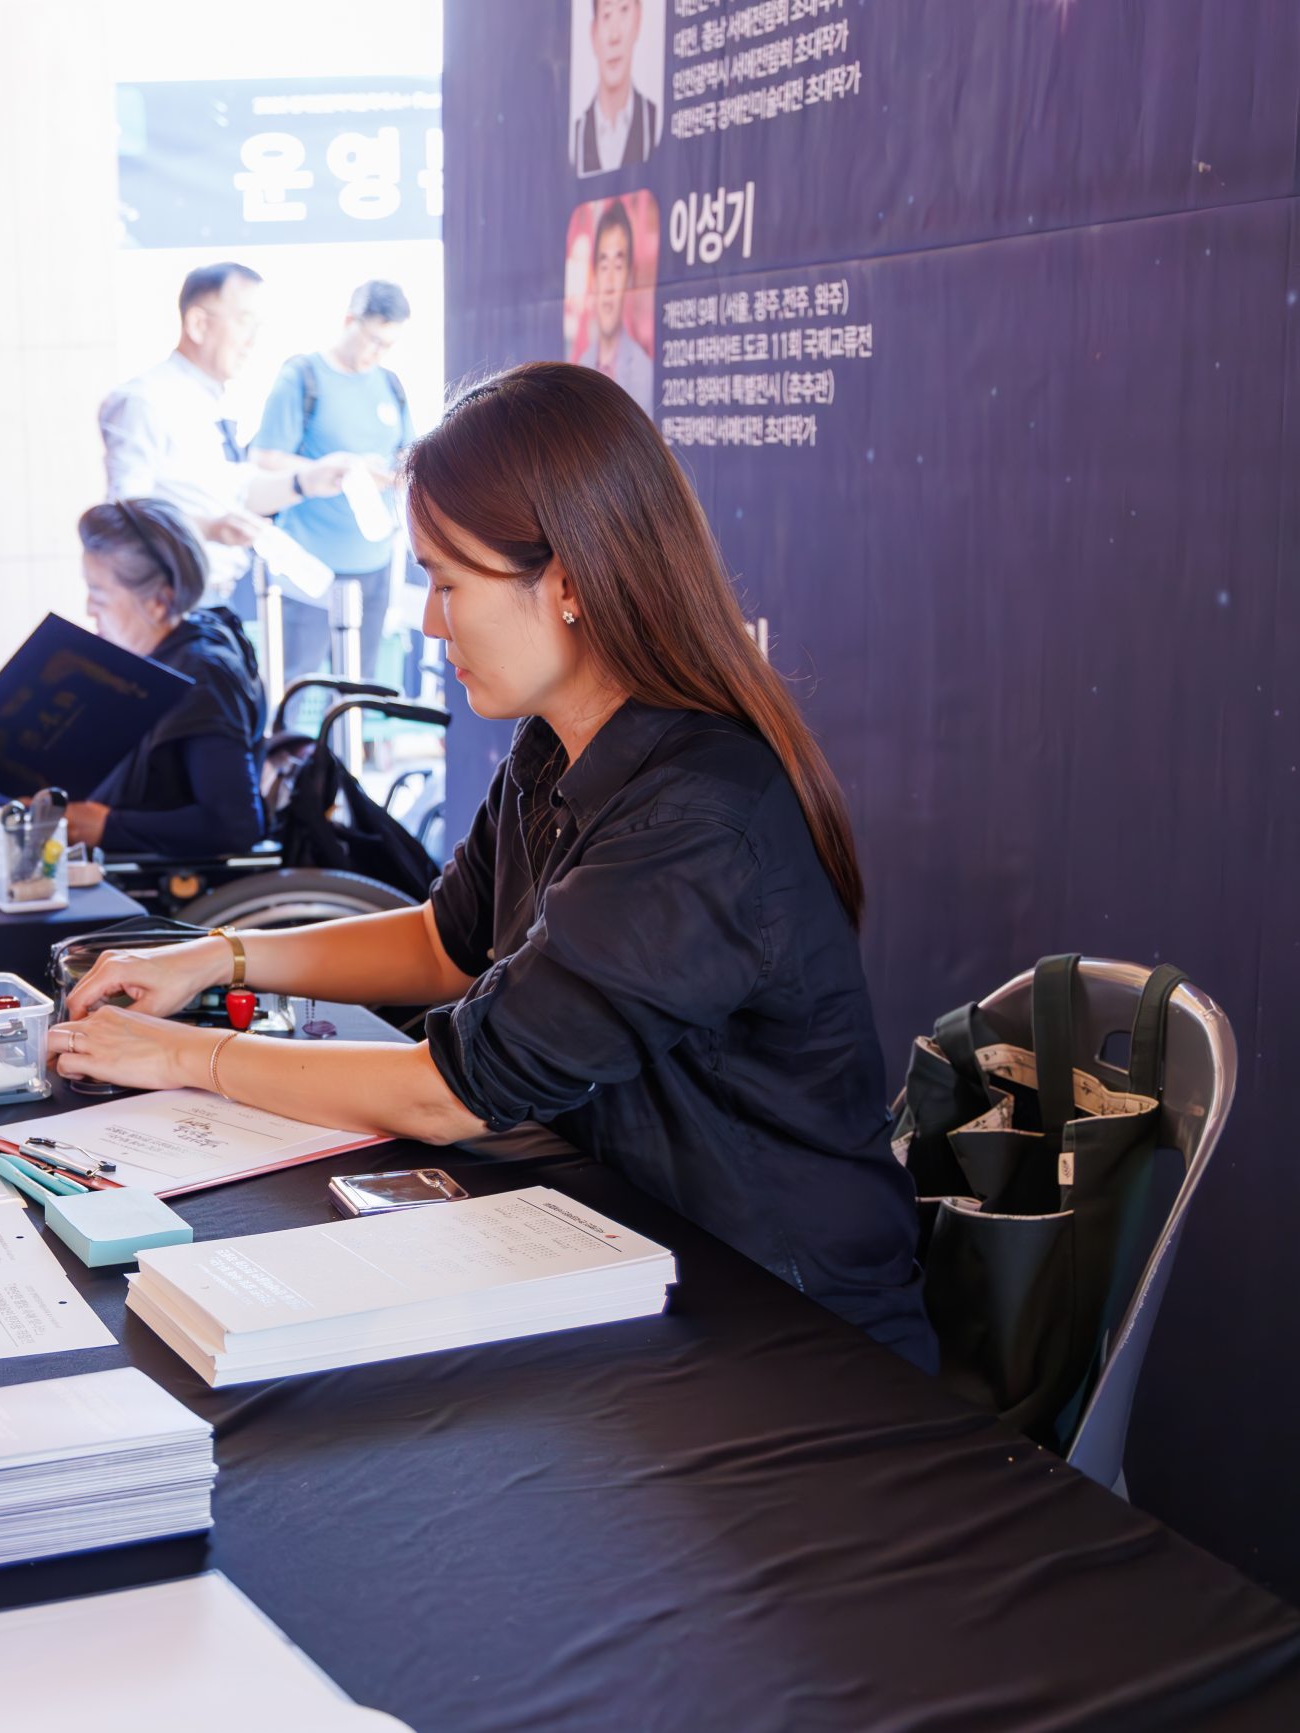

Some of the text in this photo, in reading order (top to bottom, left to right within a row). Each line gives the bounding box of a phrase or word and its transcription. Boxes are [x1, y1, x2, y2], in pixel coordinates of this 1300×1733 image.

[702, 16, 727, 51] 충남
[727, 0, 789, 42] 서예전람회
[790, 0, 844, 21] 초대
[673, 18, 849, 101] 인천광역시 서예전람회 초대작가
[671, 60, 862, 139] 대한민국 장애인미술대전 초대작가
[669, 181, 755, 265] 이성기
[663, 298, 697, 329] 개인전
[814, 279, 849, 316] 완주)
[662, 339, 695, 368] 2024
[743, 332, 769, 361] 도쿄
[771, 328, 802, 361] 11회
[803, 323, 872, 360] 국제교류전
[662, 368, 835, 406] 2024 청와대 특별전시 (춘추관)
[764, 414, 817, 447] 초대작가
